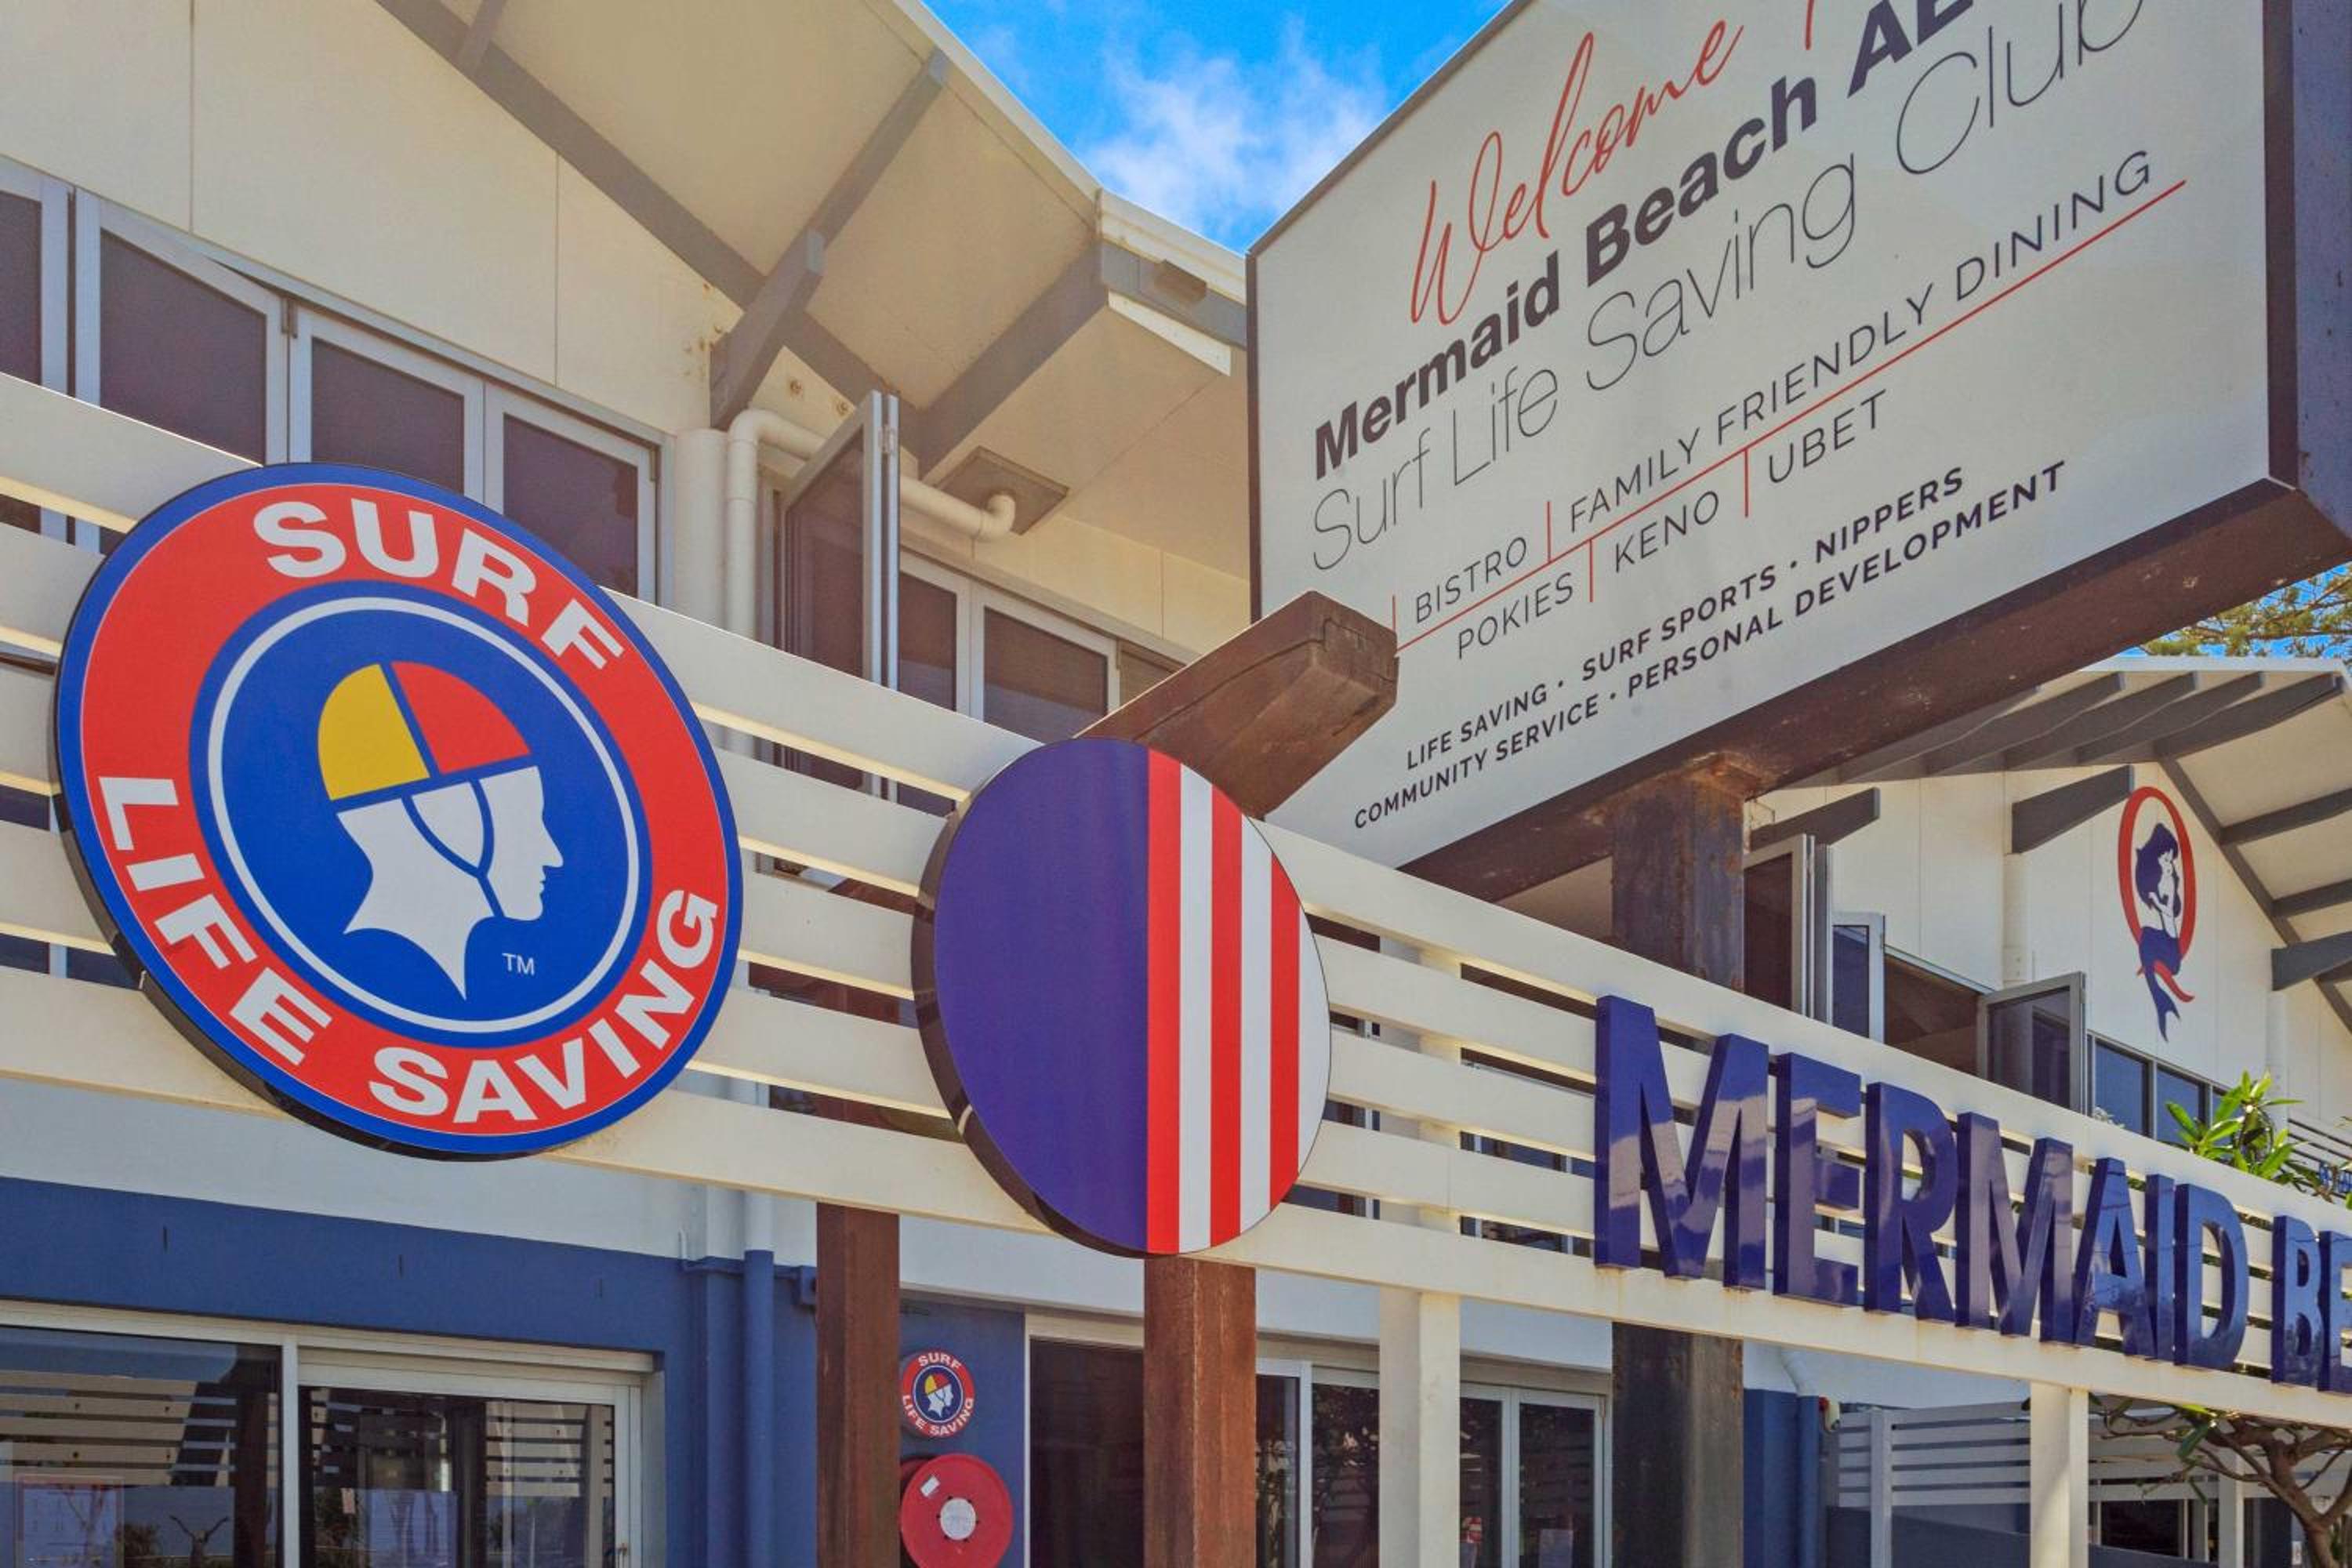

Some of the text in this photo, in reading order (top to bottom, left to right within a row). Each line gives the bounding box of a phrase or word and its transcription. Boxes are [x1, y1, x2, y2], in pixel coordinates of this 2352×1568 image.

[1313, 0, 2143, 570] Surf Life Saving Club
[1316, 249, 1560, 480] Mermaid
[1587, 75, 1817, 286] Beach
[1411, 20, 1744, 325] Welcome
[1415, 151, 2151, 624] BISTRO FAMILY FRIENDLY DINING
[1458, 389, 1887, 660] POKIES KENO UBET
[253, 497, 624, 670] SURF
[1354, 461, 2066, 829] COMMUNITY SERVICE PERSONAL DEVELOPMENT
[1407, 466, 1963, 771] LIFE SAVING SURF SPORTS NIPPERS
[99, 776, 719, 1123] LIFE SAVING
[502, 953, 535, 976] TM
[1595, 995, 2249, 1368] MERMAID
[902, 1395, 975, 1436] LIFE SAVING
[918, 1352, 962, 1369] SURF
